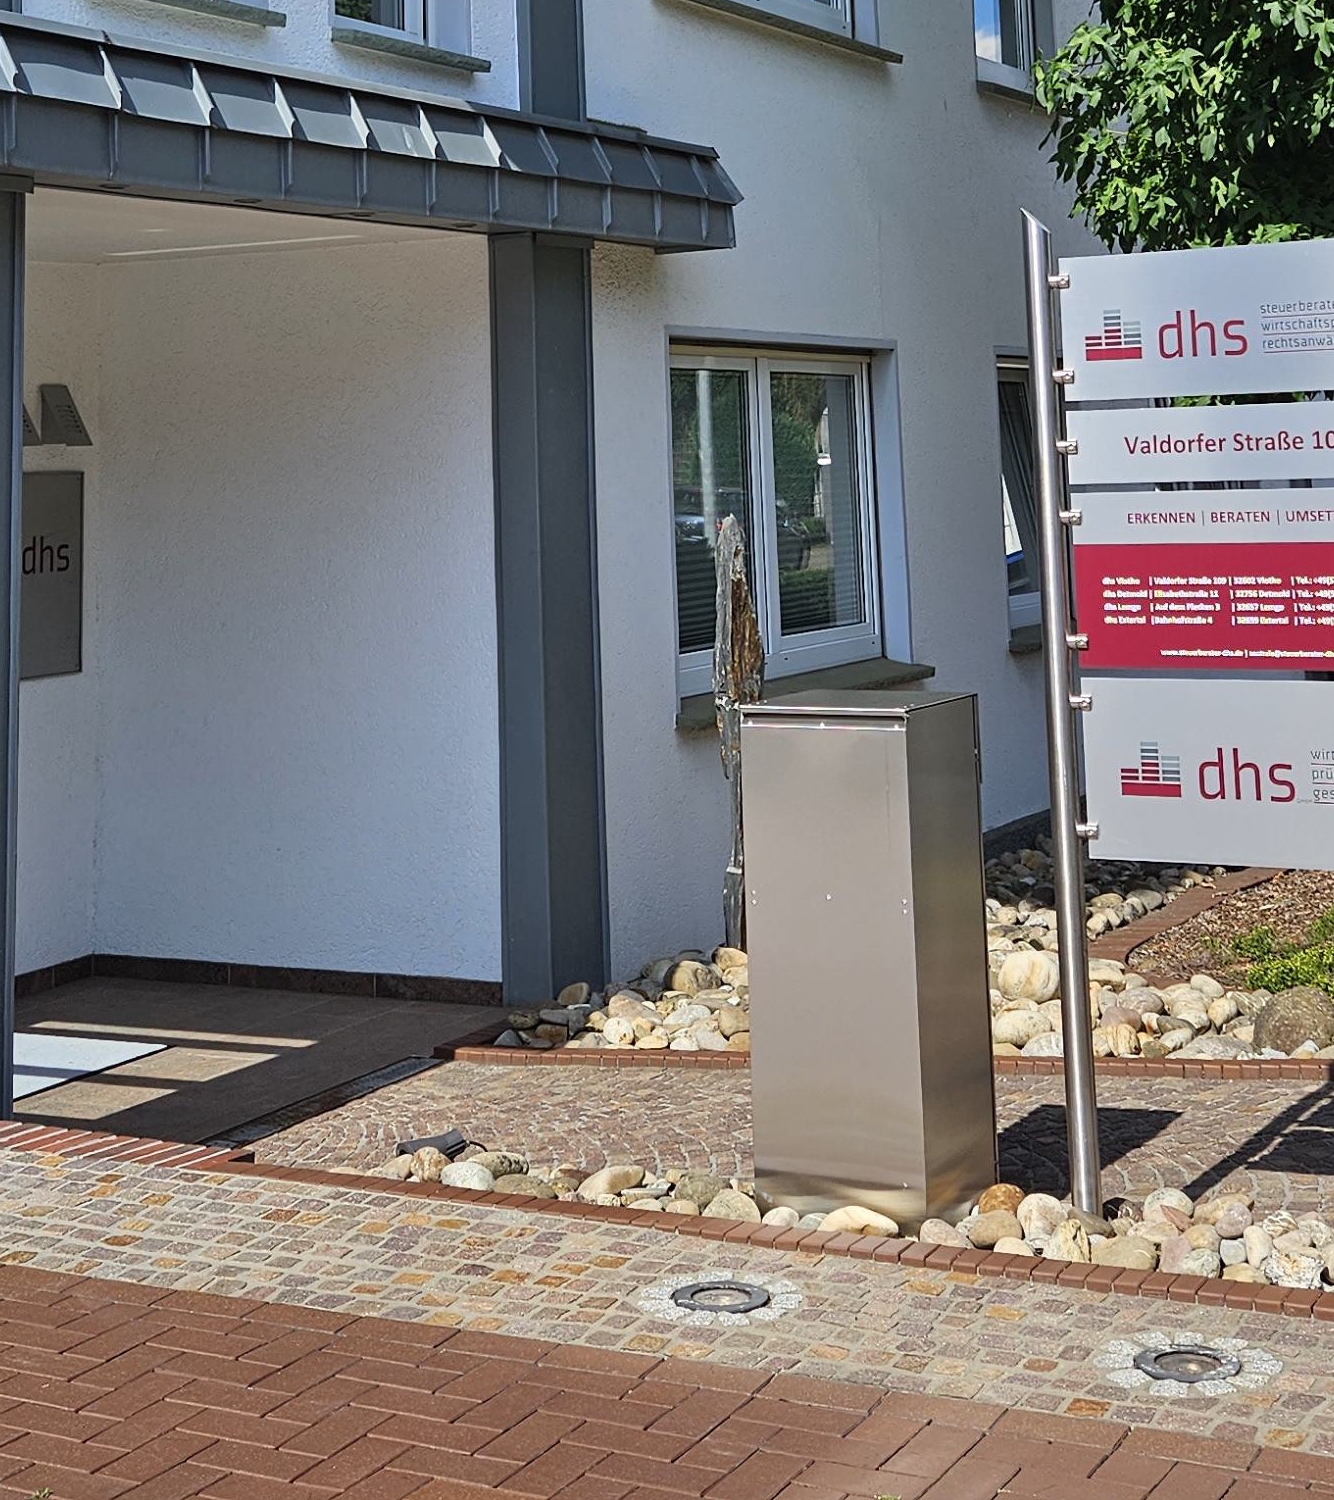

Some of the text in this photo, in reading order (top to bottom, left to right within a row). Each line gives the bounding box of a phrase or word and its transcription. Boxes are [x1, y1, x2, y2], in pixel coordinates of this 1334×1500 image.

[1158, 309, 1248, 360] dhs
[1123, 432, 1227, 455] Valdorfer
[1232, 430, 1305, 452] Straße
[1127, 512, 1196, 525] ERKENNEN
[1210, 510, 1271, 524] BERATEN
[22, 536, 69, 575] dhs
[1153, 576, 1187, 585] Valdorfer
[1188, 576, 1212, 585] Straße
[1213, 576, 1227, 585] 109
[1198, 746, 1296, 803] dhs
